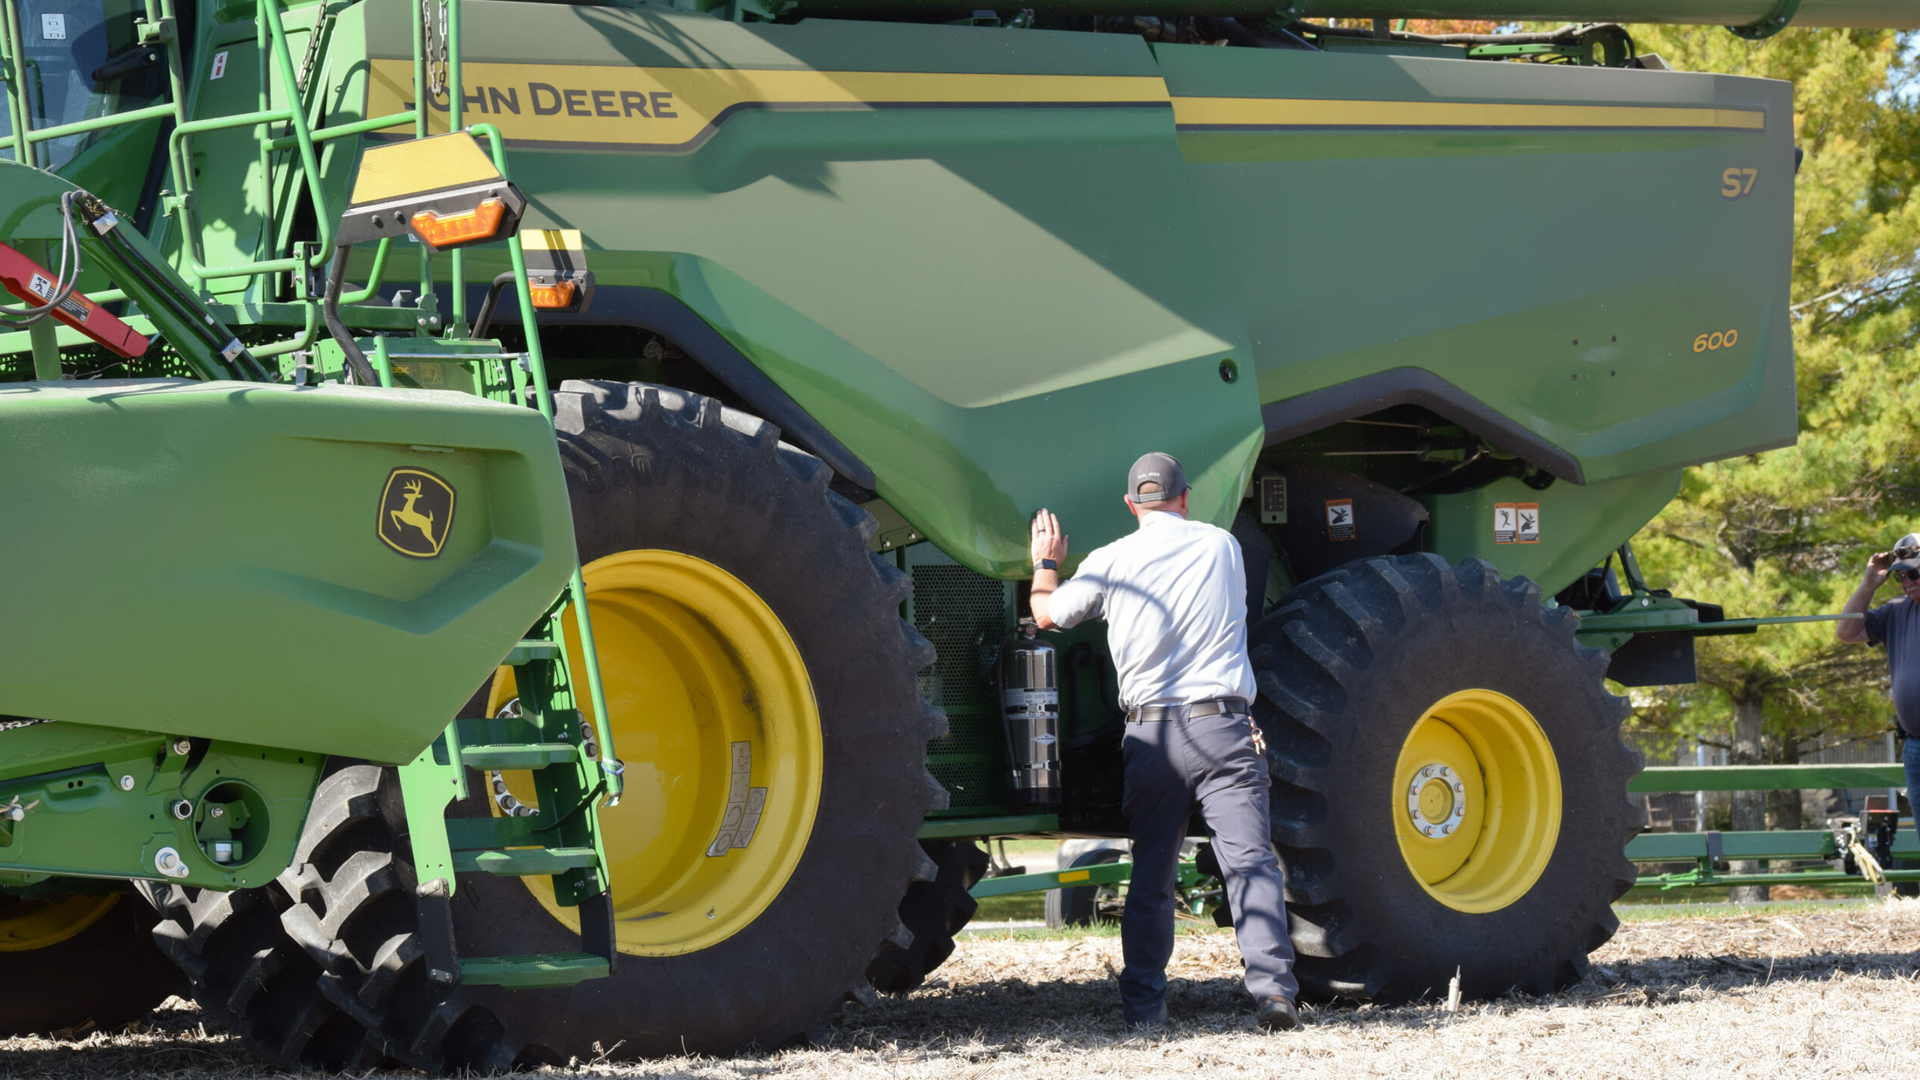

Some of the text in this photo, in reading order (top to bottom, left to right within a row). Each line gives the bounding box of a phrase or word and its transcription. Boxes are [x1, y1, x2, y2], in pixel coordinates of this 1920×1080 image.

[528, 82, 678, 118] DEERE
[1721, 167, 1758, 198] S7
[1693, 329, 1739, 353] 600
